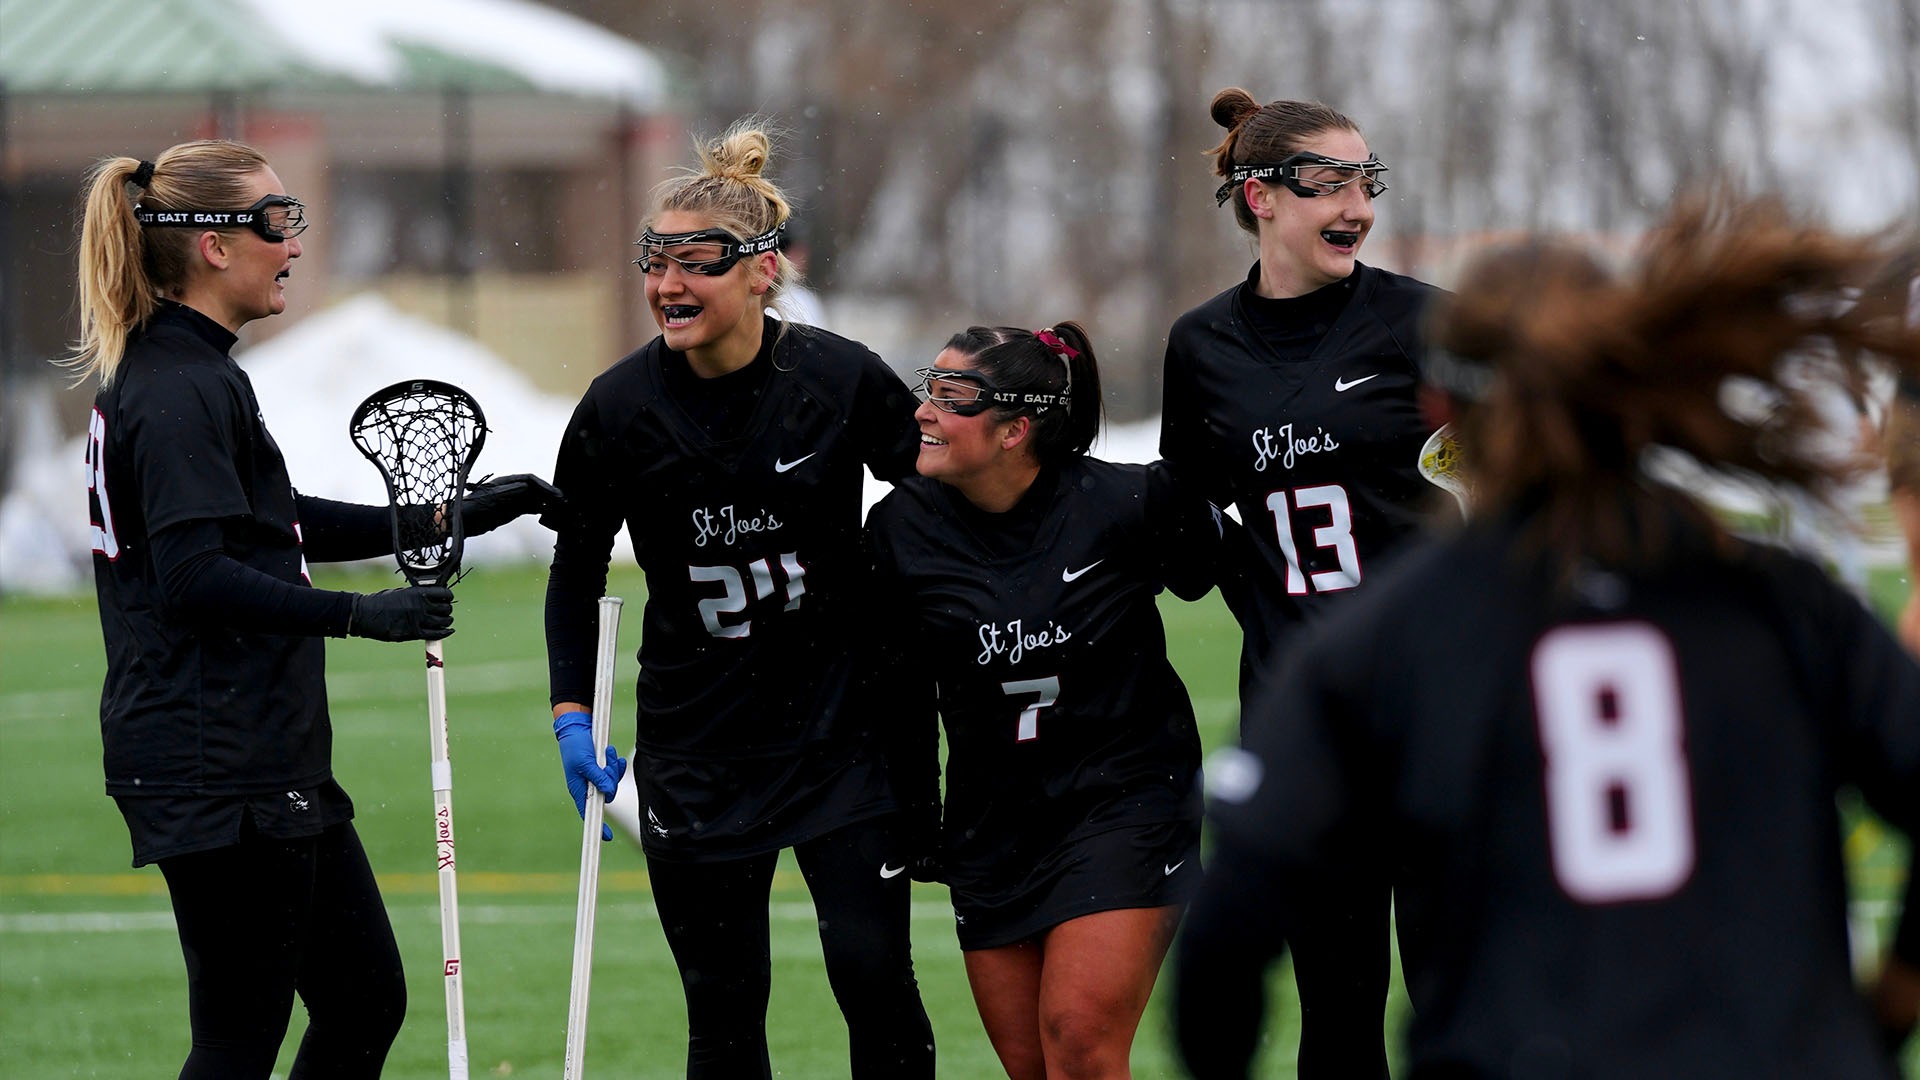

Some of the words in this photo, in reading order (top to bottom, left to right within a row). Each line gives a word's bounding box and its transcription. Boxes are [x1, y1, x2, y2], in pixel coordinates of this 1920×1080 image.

[1251, 167, 1275, 178] GAIT
[157, 213, 189, 223] GAIT
[194, 213, 231, 223] GAIT
[1024, 394, 1056, 404] GAIT
[1265, 481, 1363, 596] 13
[1001, 675, 1062, 744] 7
[1530, 618, 1696, 904] 8
